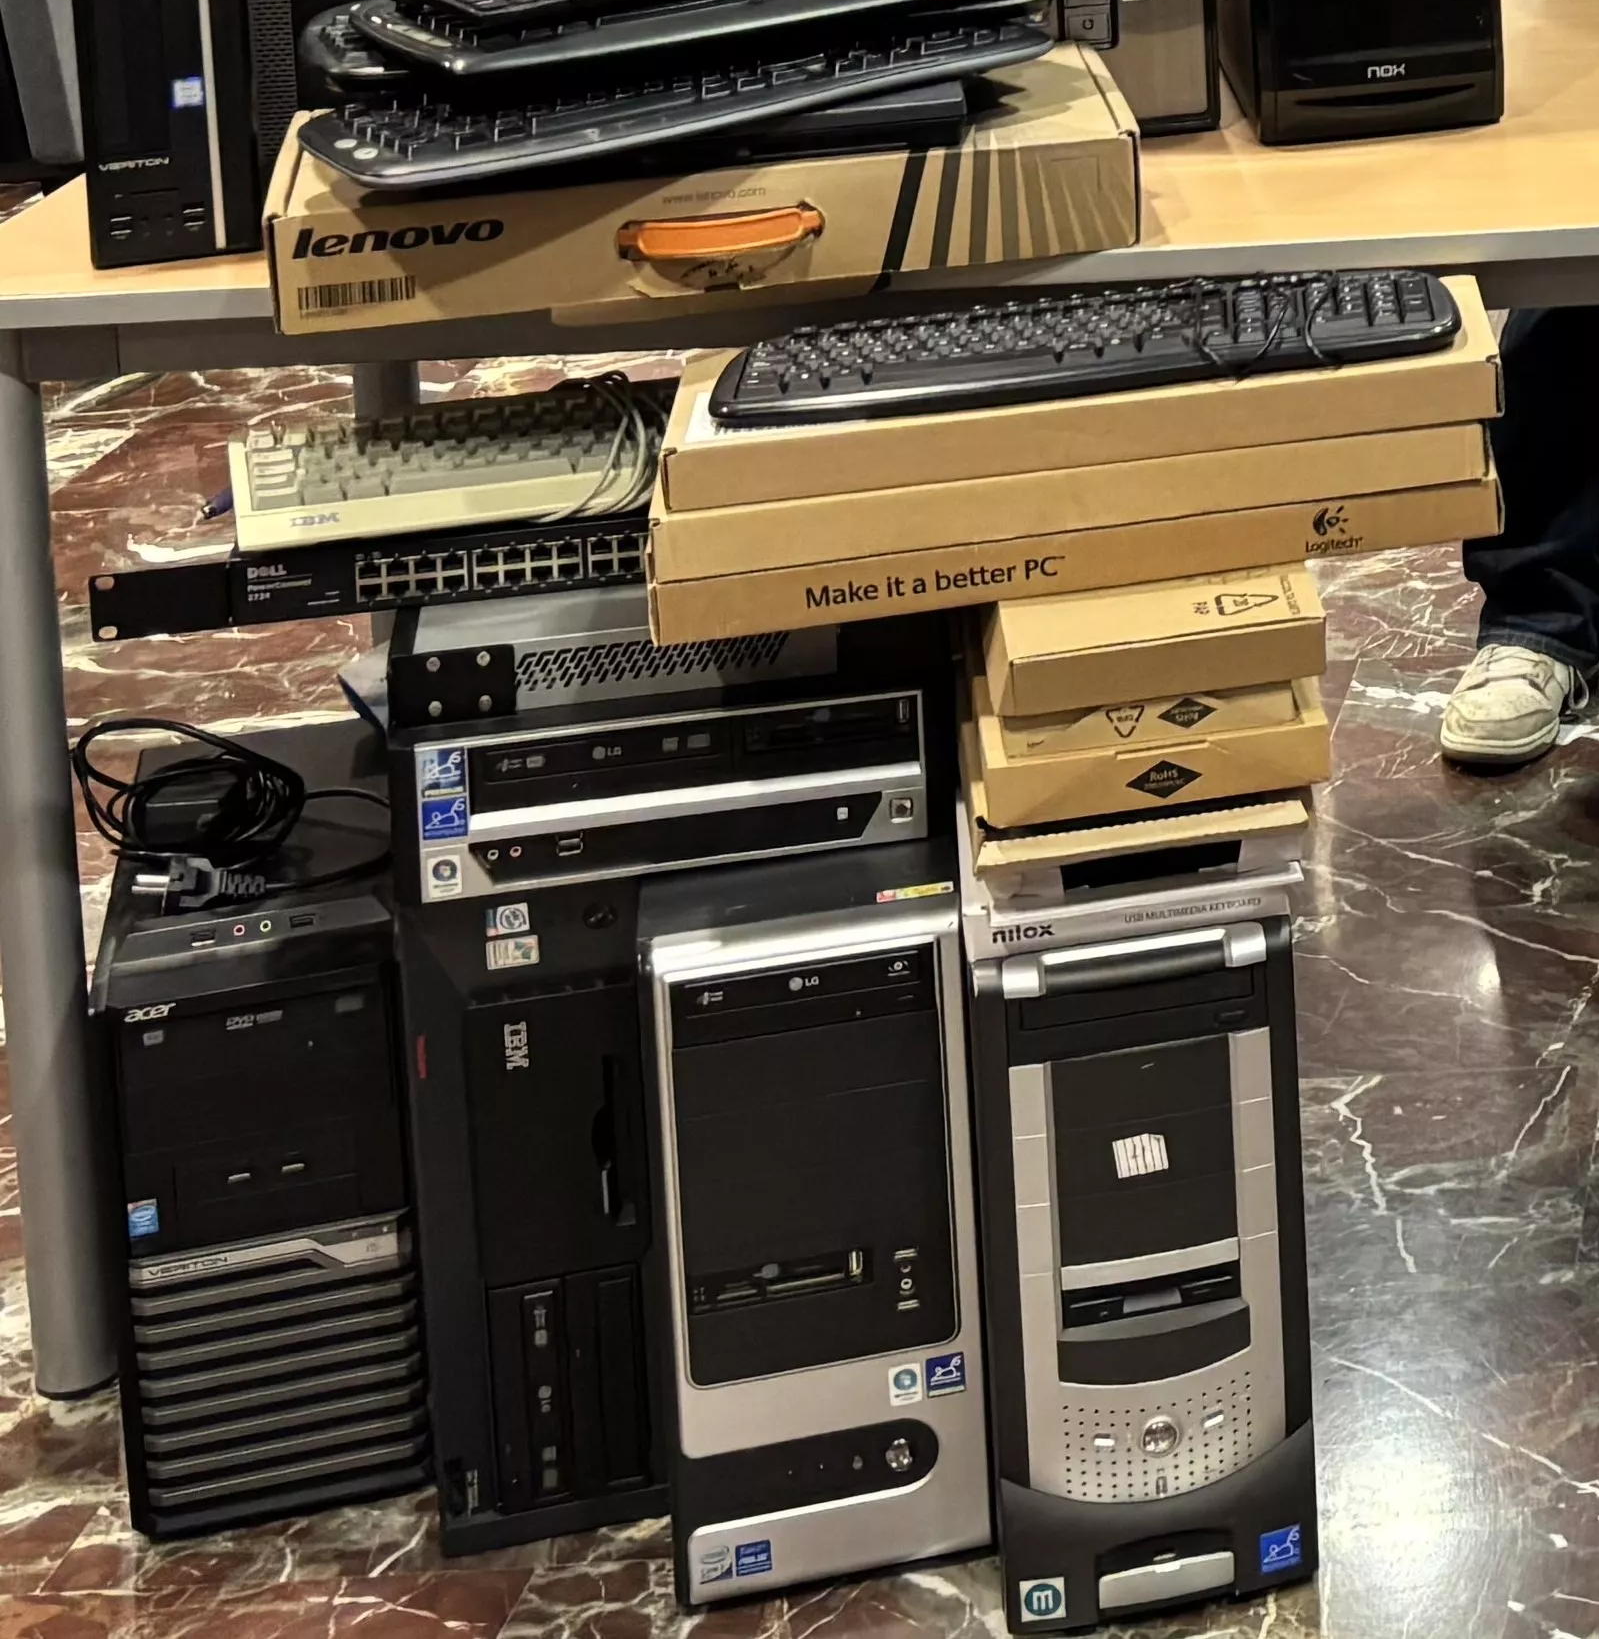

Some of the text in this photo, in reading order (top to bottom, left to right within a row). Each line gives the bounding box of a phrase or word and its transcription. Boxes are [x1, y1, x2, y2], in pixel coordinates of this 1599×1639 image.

[292, 219, 505, 261] lenovo
[291, 512, 341, 527] IBM
[1305, 535, 1362, 555] Logitech
[805, 579, 879, 609] Make
[886, 576, 906, 598] it
[912, 577, 927, 595] a
[935, 564, 1017, 591] better
[1124, 896, 1262, 923] USB MULTIMEDIA KEYBOARD
[992, 922, 1056, 944] nilox
[805, 976, 819, 986] LG
[124, 1002, 177, 1023] acer
[504, 1021, 530, 1071] IBM
